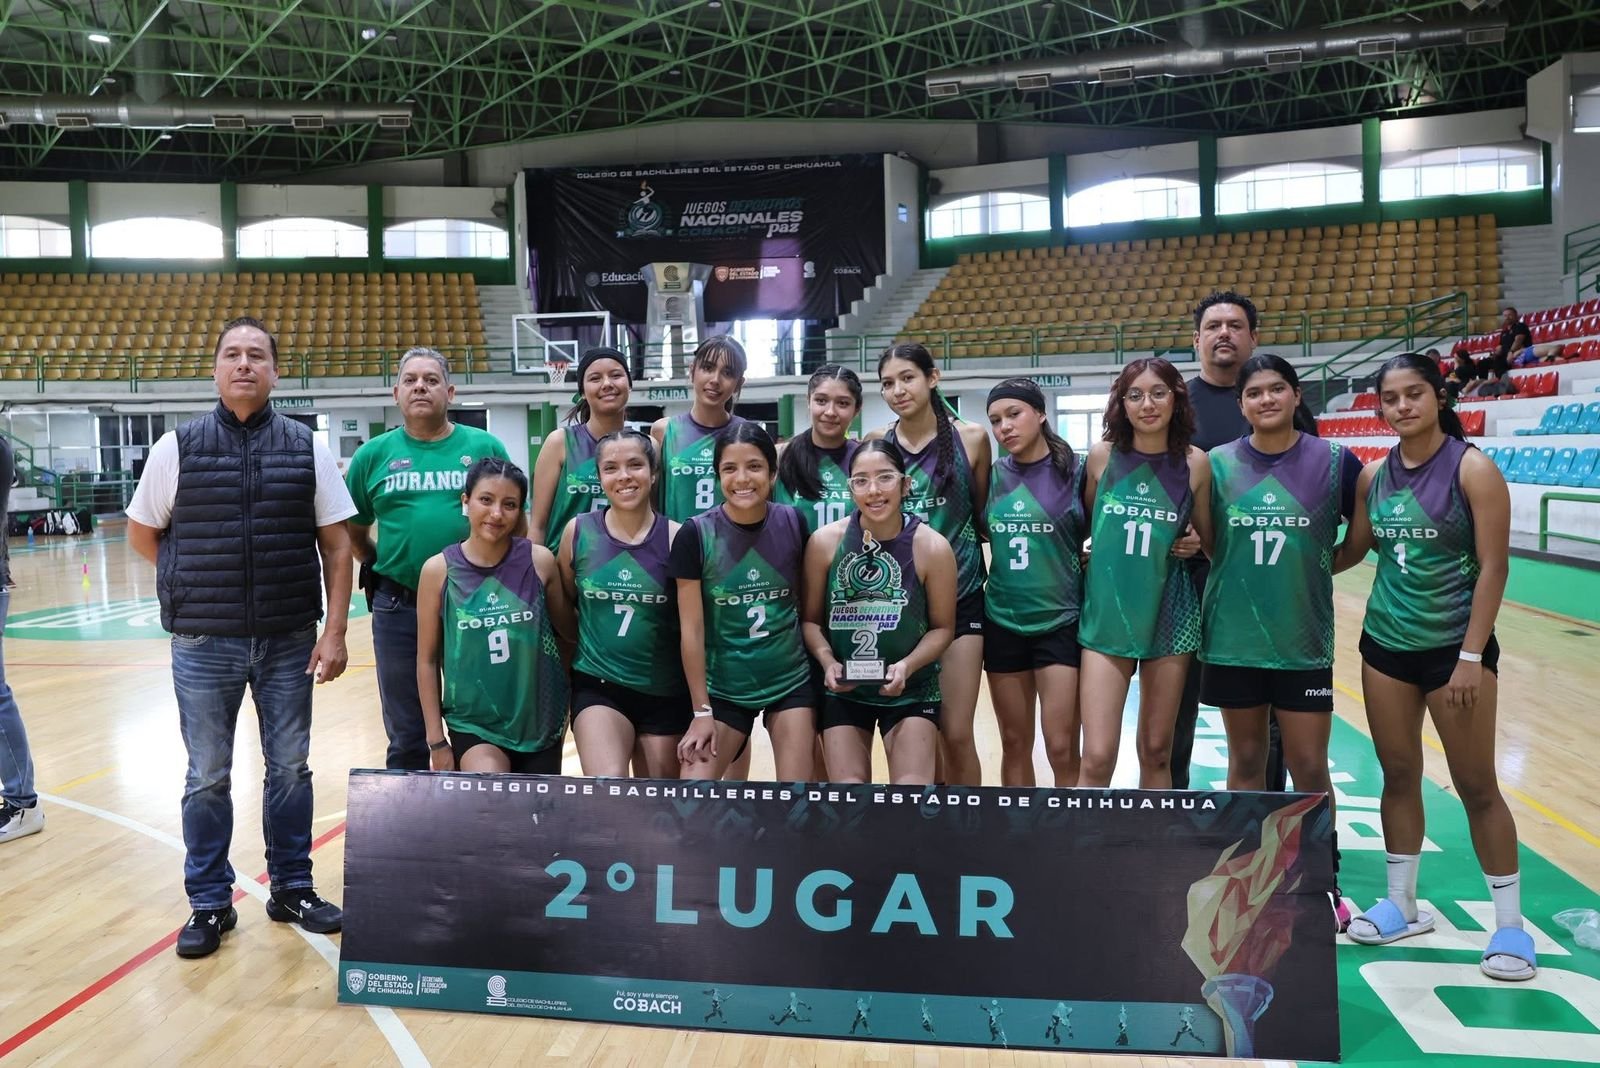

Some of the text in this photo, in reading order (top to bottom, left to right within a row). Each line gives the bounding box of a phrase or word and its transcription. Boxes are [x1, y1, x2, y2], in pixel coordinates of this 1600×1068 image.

[576, 171, 618, 179] COLEGIO
[619, 170, 633, 178] DE
[635, 167, 700, 177] BACHILLERES
[724, 164, 765, 172] ESTADO
[783, 161, 842, 170] CHIHUAHUA
[683, 201, 727, 215] JUEGOS
[680, 210, 804, 227] NACIONALES
[766, 222, 801, 238] paz
[1031, 376, 1070, 386] SALIDA
[650, 389, 687, 400] SALIDA
[671, 465, 716, 476] COBA
[384, 470, 467, 493] DURANG
[695, 478, 715, 509] 8
[1125, 495, 1157, 503] DURANGO
[903, 496, 947, 510] BAED
[1102, 504, 1178, 522] COBAED
[989, 522, 1055, 533] COBAED
[1228, 516, 1311, 527] COBAED
[1123, 520, 1153, 558] 11
[1008, 536, 1029, 570] 3
[1250, 530, 1287, 566] 17
[1393, 542, 1409, 575] 1
[738, 581, 770, 590] DURANGO
[583, 590, 668, 604] COBAED
[714, 588, 790, 605] COBAED
[478, 604, 510, 612] DURANGO
[833, 605, 900, 614] JUEGOS DEPORTIVOS
[457, 610, 534, 630] COBAED
[614, 604, 635, 637] 7
[746, 605, 770, 639] 2
[832, 614, 899, 622] NACIONALES
[877, 621, 896, 631] paz
[487, 629, 510, 665] 9
[853, 629, 876, 658] 2
[1305, 688, 1333, 696] molte
[443, 780, 1216, 809] COLEGIO DE BACHILLERES DEL ESTADO DE CHIHUAHUA
[655, 864, 1015, 939] LUGAR
[367, 980, 414, 989] DEL ESTADO
[368, 973, 408, 982] GOBIERNO
[377, 987, 414, 995] CHIHUAHUA
[613, 997, 682, 1015] COBACH
